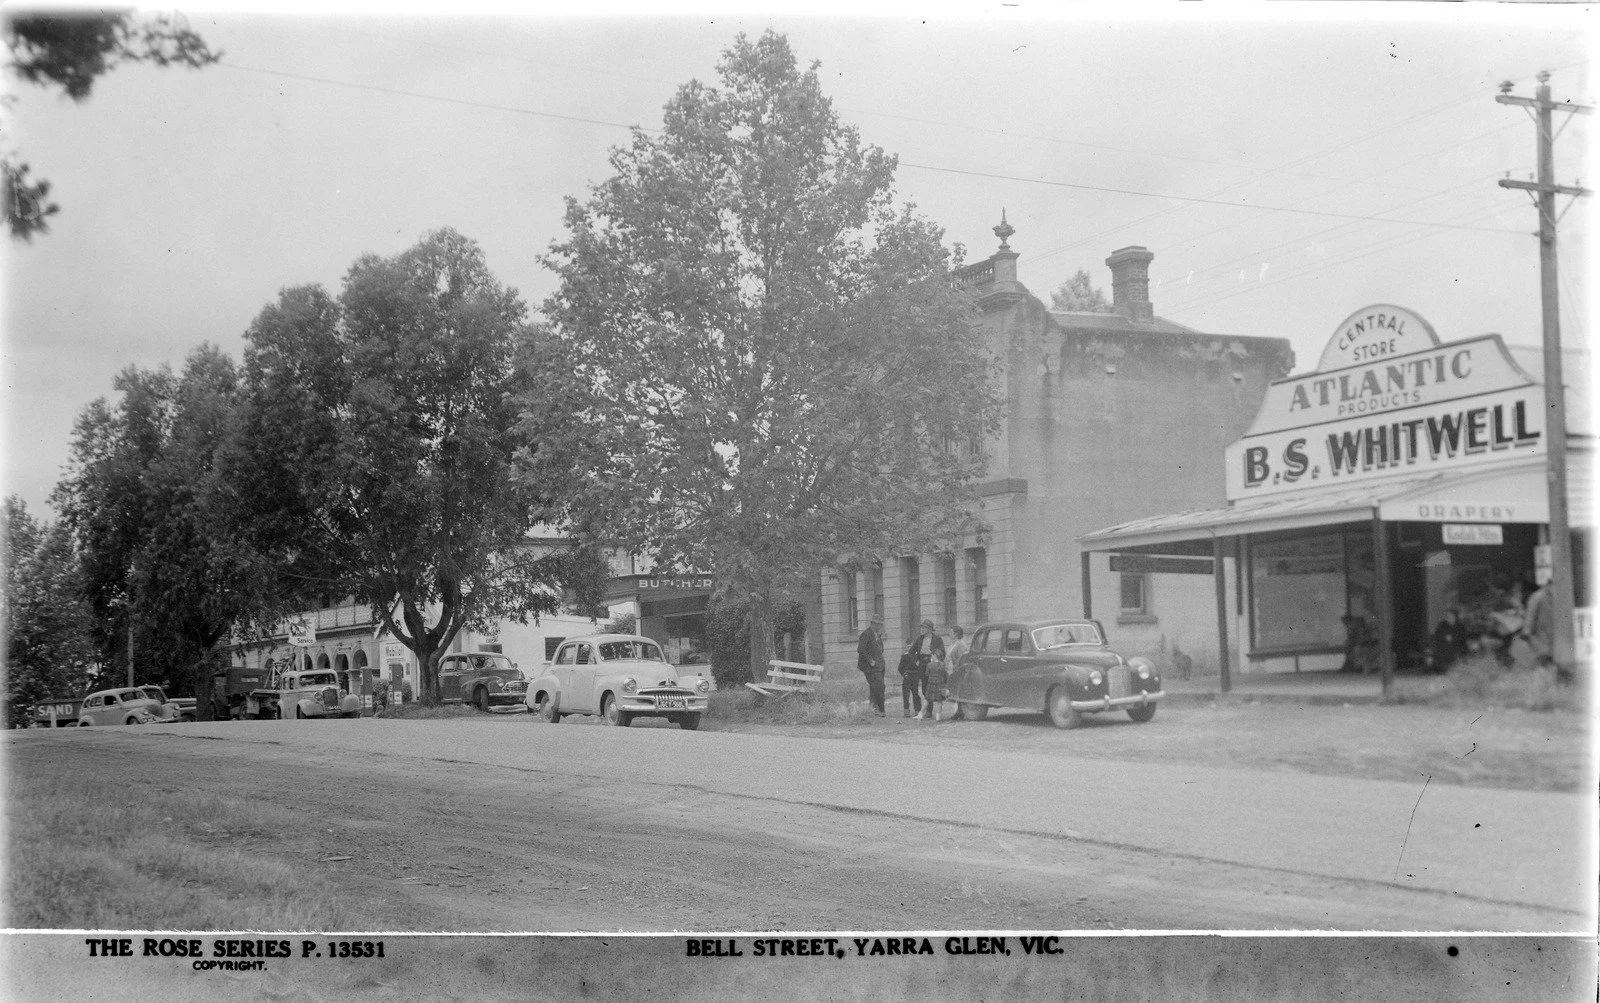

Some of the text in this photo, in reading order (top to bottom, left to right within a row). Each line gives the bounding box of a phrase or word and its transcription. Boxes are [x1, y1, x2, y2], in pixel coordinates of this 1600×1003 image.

[1338, 313, 1407, 351] CENTRAL
[1353, 338, 1397, 361] STORE
[1289, 350, 1472, 412] ATLANTIC
[1338, 389, 1422, 416] PRODUCTS
[1243, 400, 1541, 489] B.S. WHITWELL
[1419, 504, 1516, 519] DRAPERY
[37, 703, 74, 716] SAND
